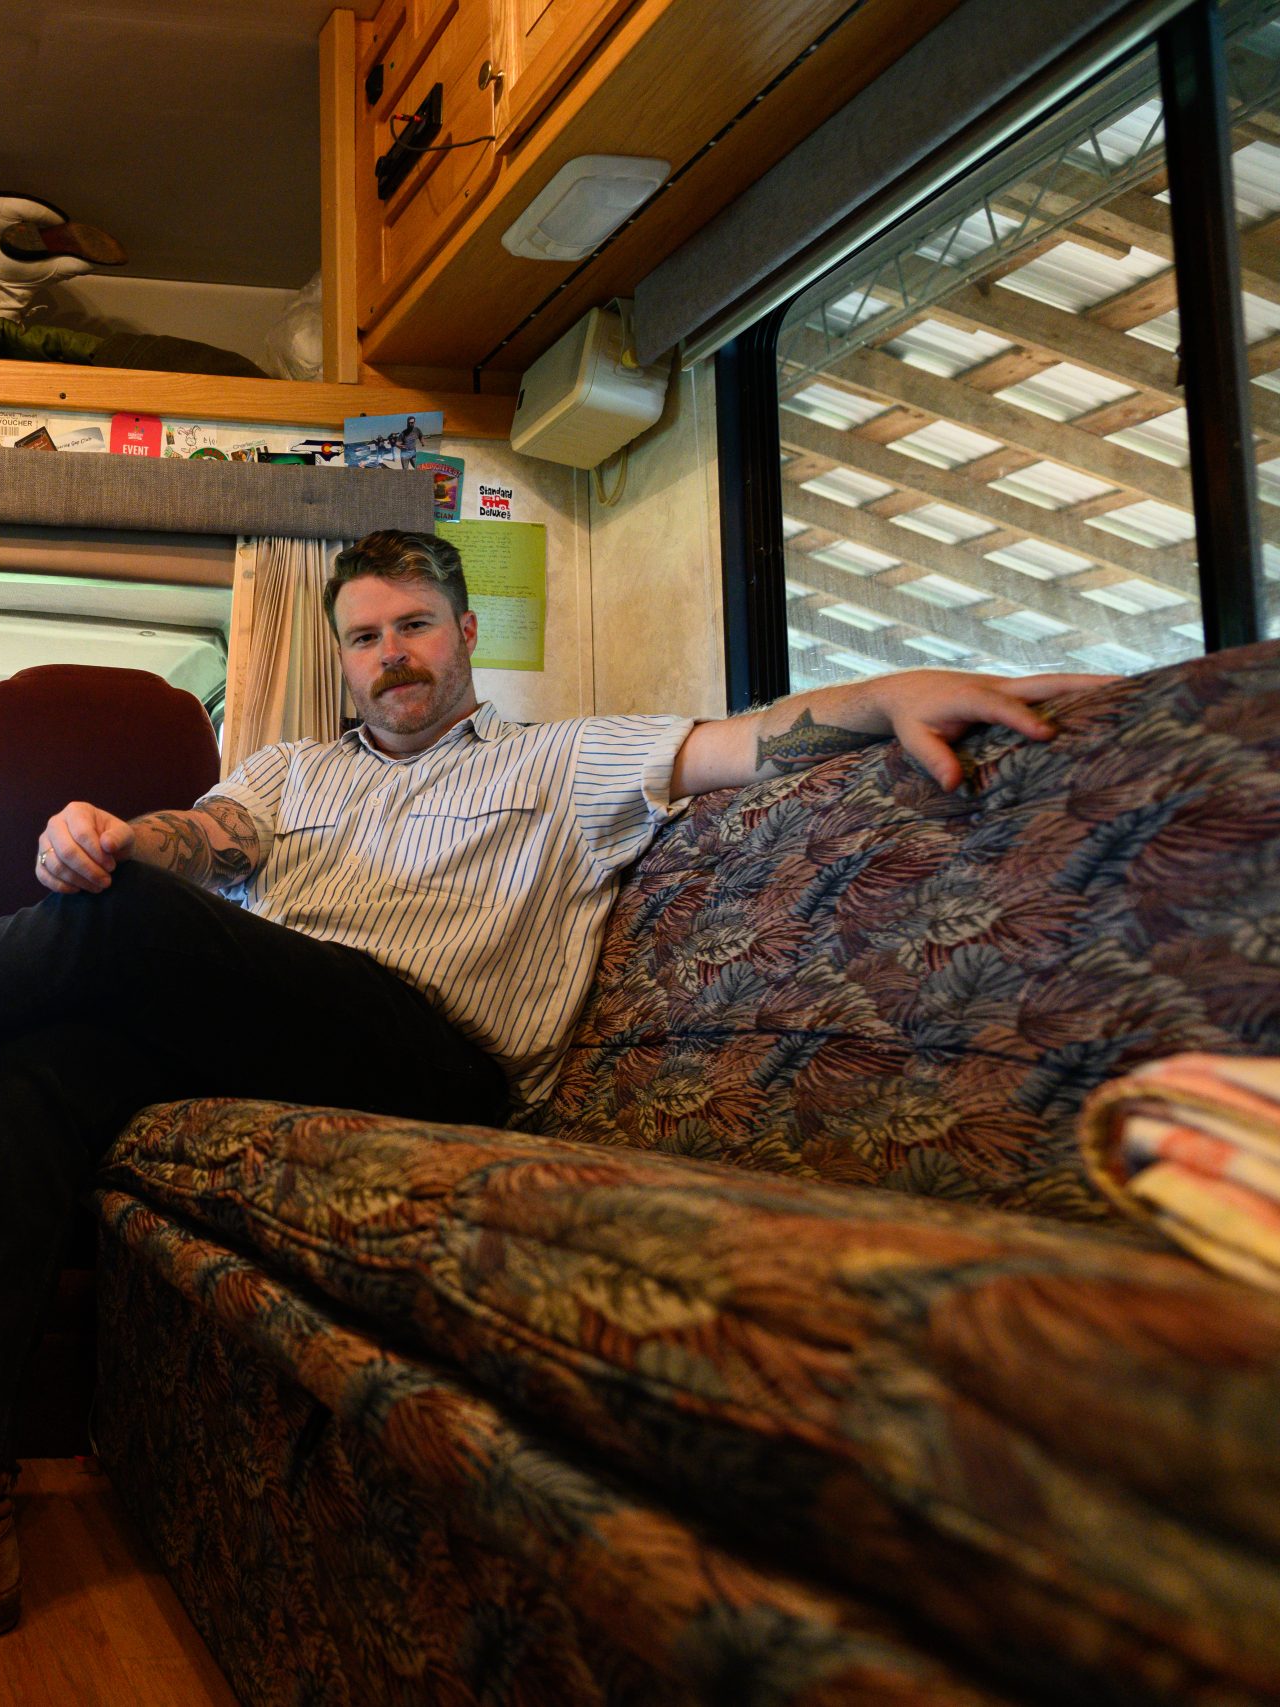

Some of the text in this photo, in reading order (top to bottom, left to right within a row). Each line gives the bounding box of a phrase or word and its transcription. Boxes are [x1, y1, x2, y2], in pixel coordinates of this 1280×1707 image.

[122, 443, 150, 457] EVENT
[479, 485, 513, 499] Standard
[479, 506, 507, 519] Deluxe
